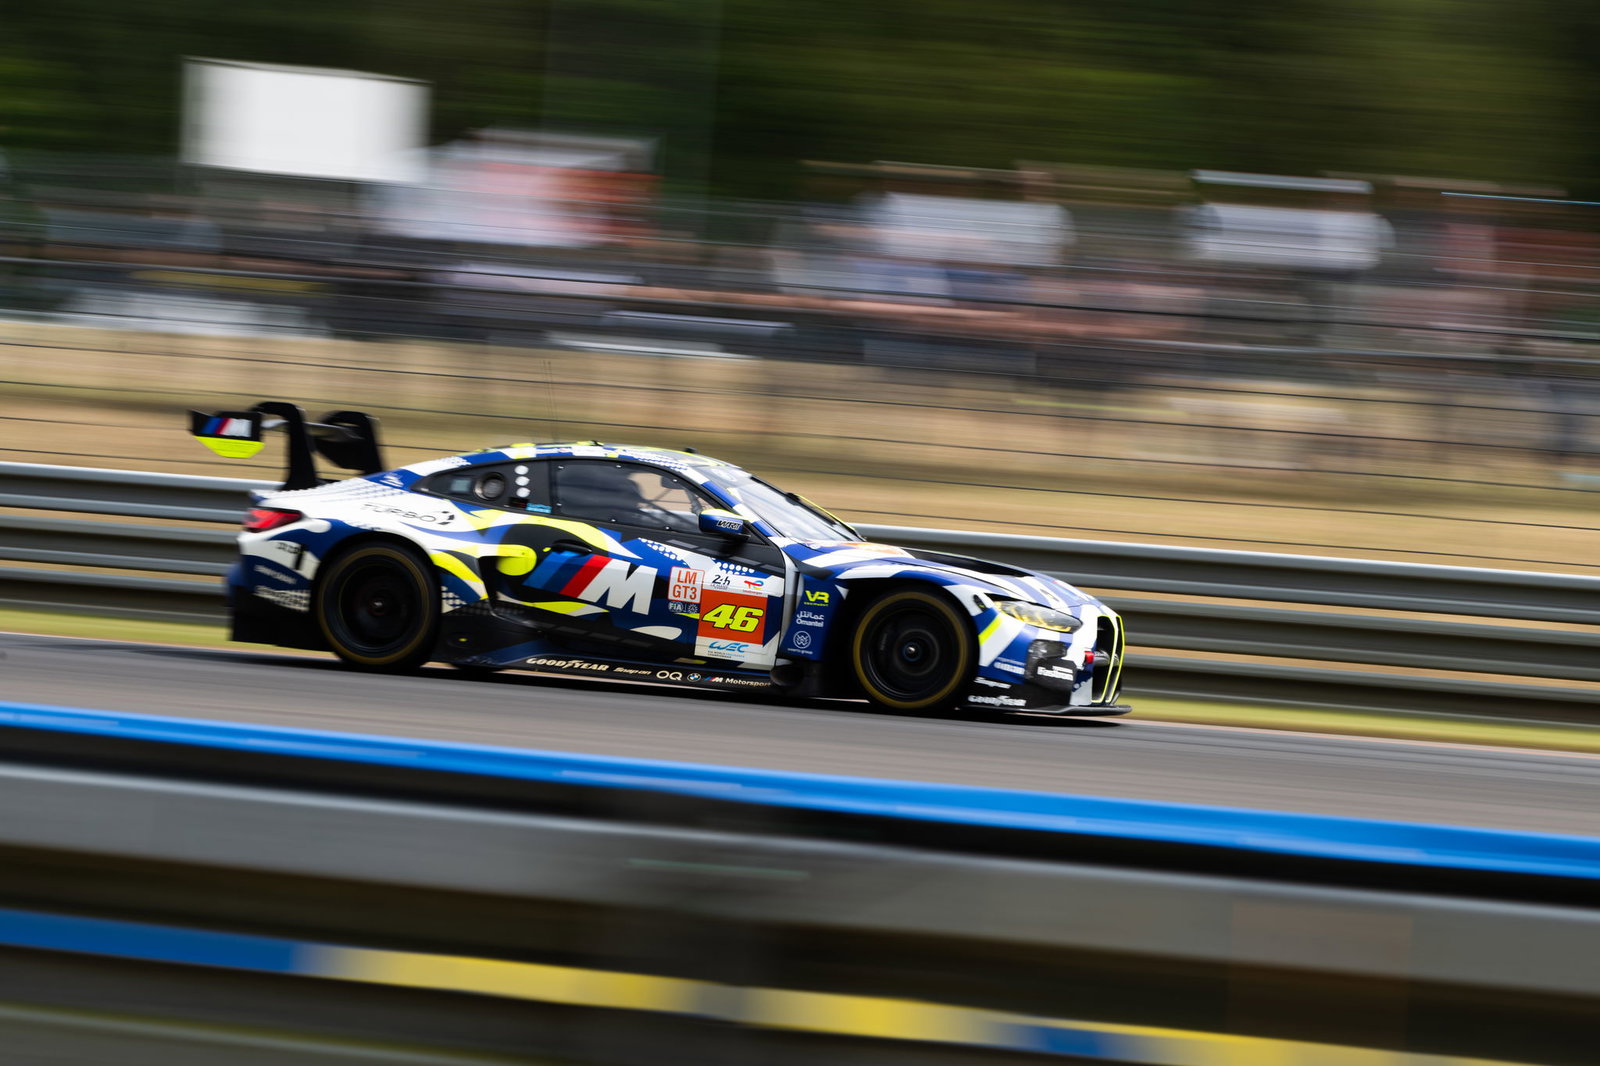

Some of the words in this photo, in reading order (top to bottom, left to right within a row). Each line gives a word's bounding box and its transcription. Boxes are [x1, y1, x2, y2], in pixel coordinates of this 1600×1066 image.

[676, 570, 698, 585] LM
[672, 584, 698, 600] GT3
[804, 589, 830, 604] VR
[701, 603, 765, 634] 46
[708, 641, 749, 653] WEC
[526, 658, 610, 671] GOODYEAR
[655, 669, 683, 681] OQ
[725, 678, 771, 687] Motorsport
